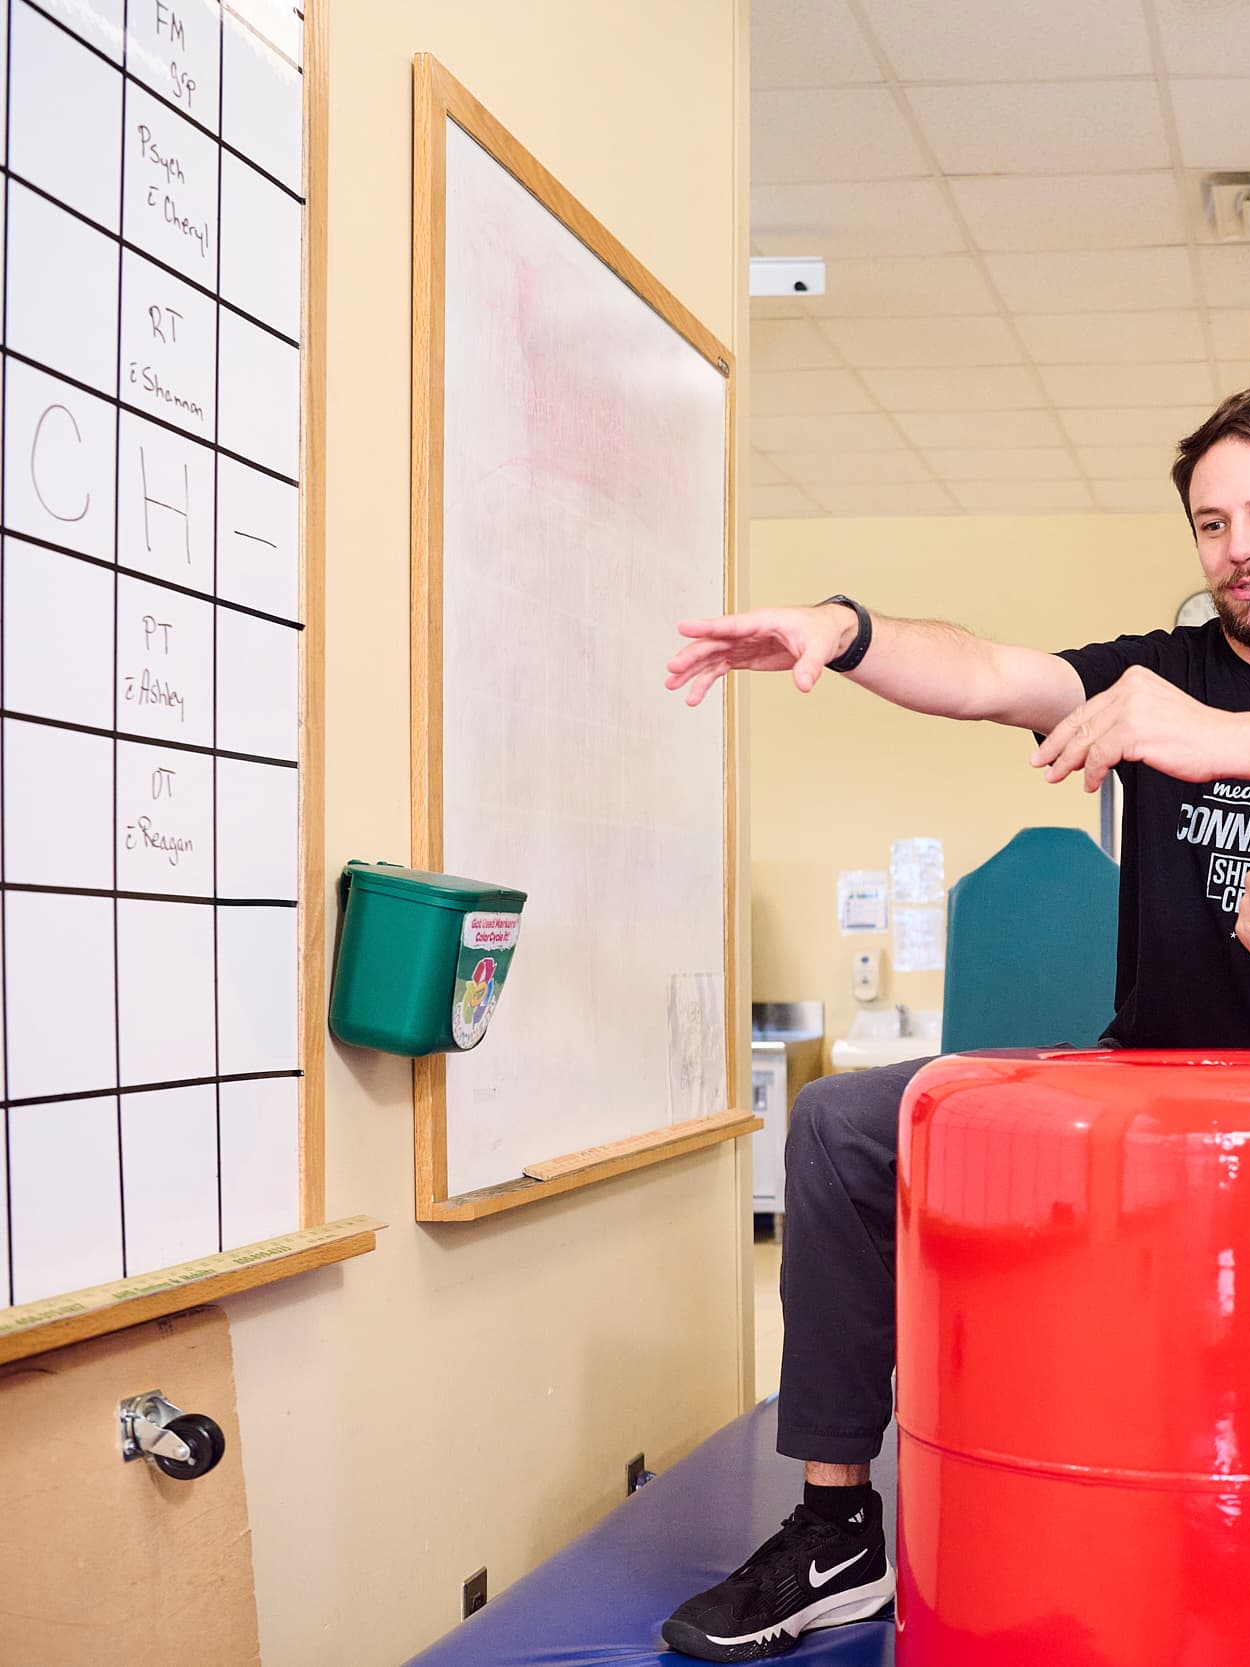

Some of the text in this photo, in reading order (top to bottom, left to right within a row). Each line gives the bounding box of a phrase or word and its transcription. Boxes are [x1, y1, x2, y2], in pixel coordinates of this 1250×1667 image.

[138, 125, 185, 184] Psych
[164, 197, 209, 258] Cheryl
[149, 305, 184, 344] RT
[143, 366, 204, 421] Shannon
[142, 615, 173, 655] PT
[139, 668, 185, 723] Ashley
[138, 815, 193, 866] Reagan
